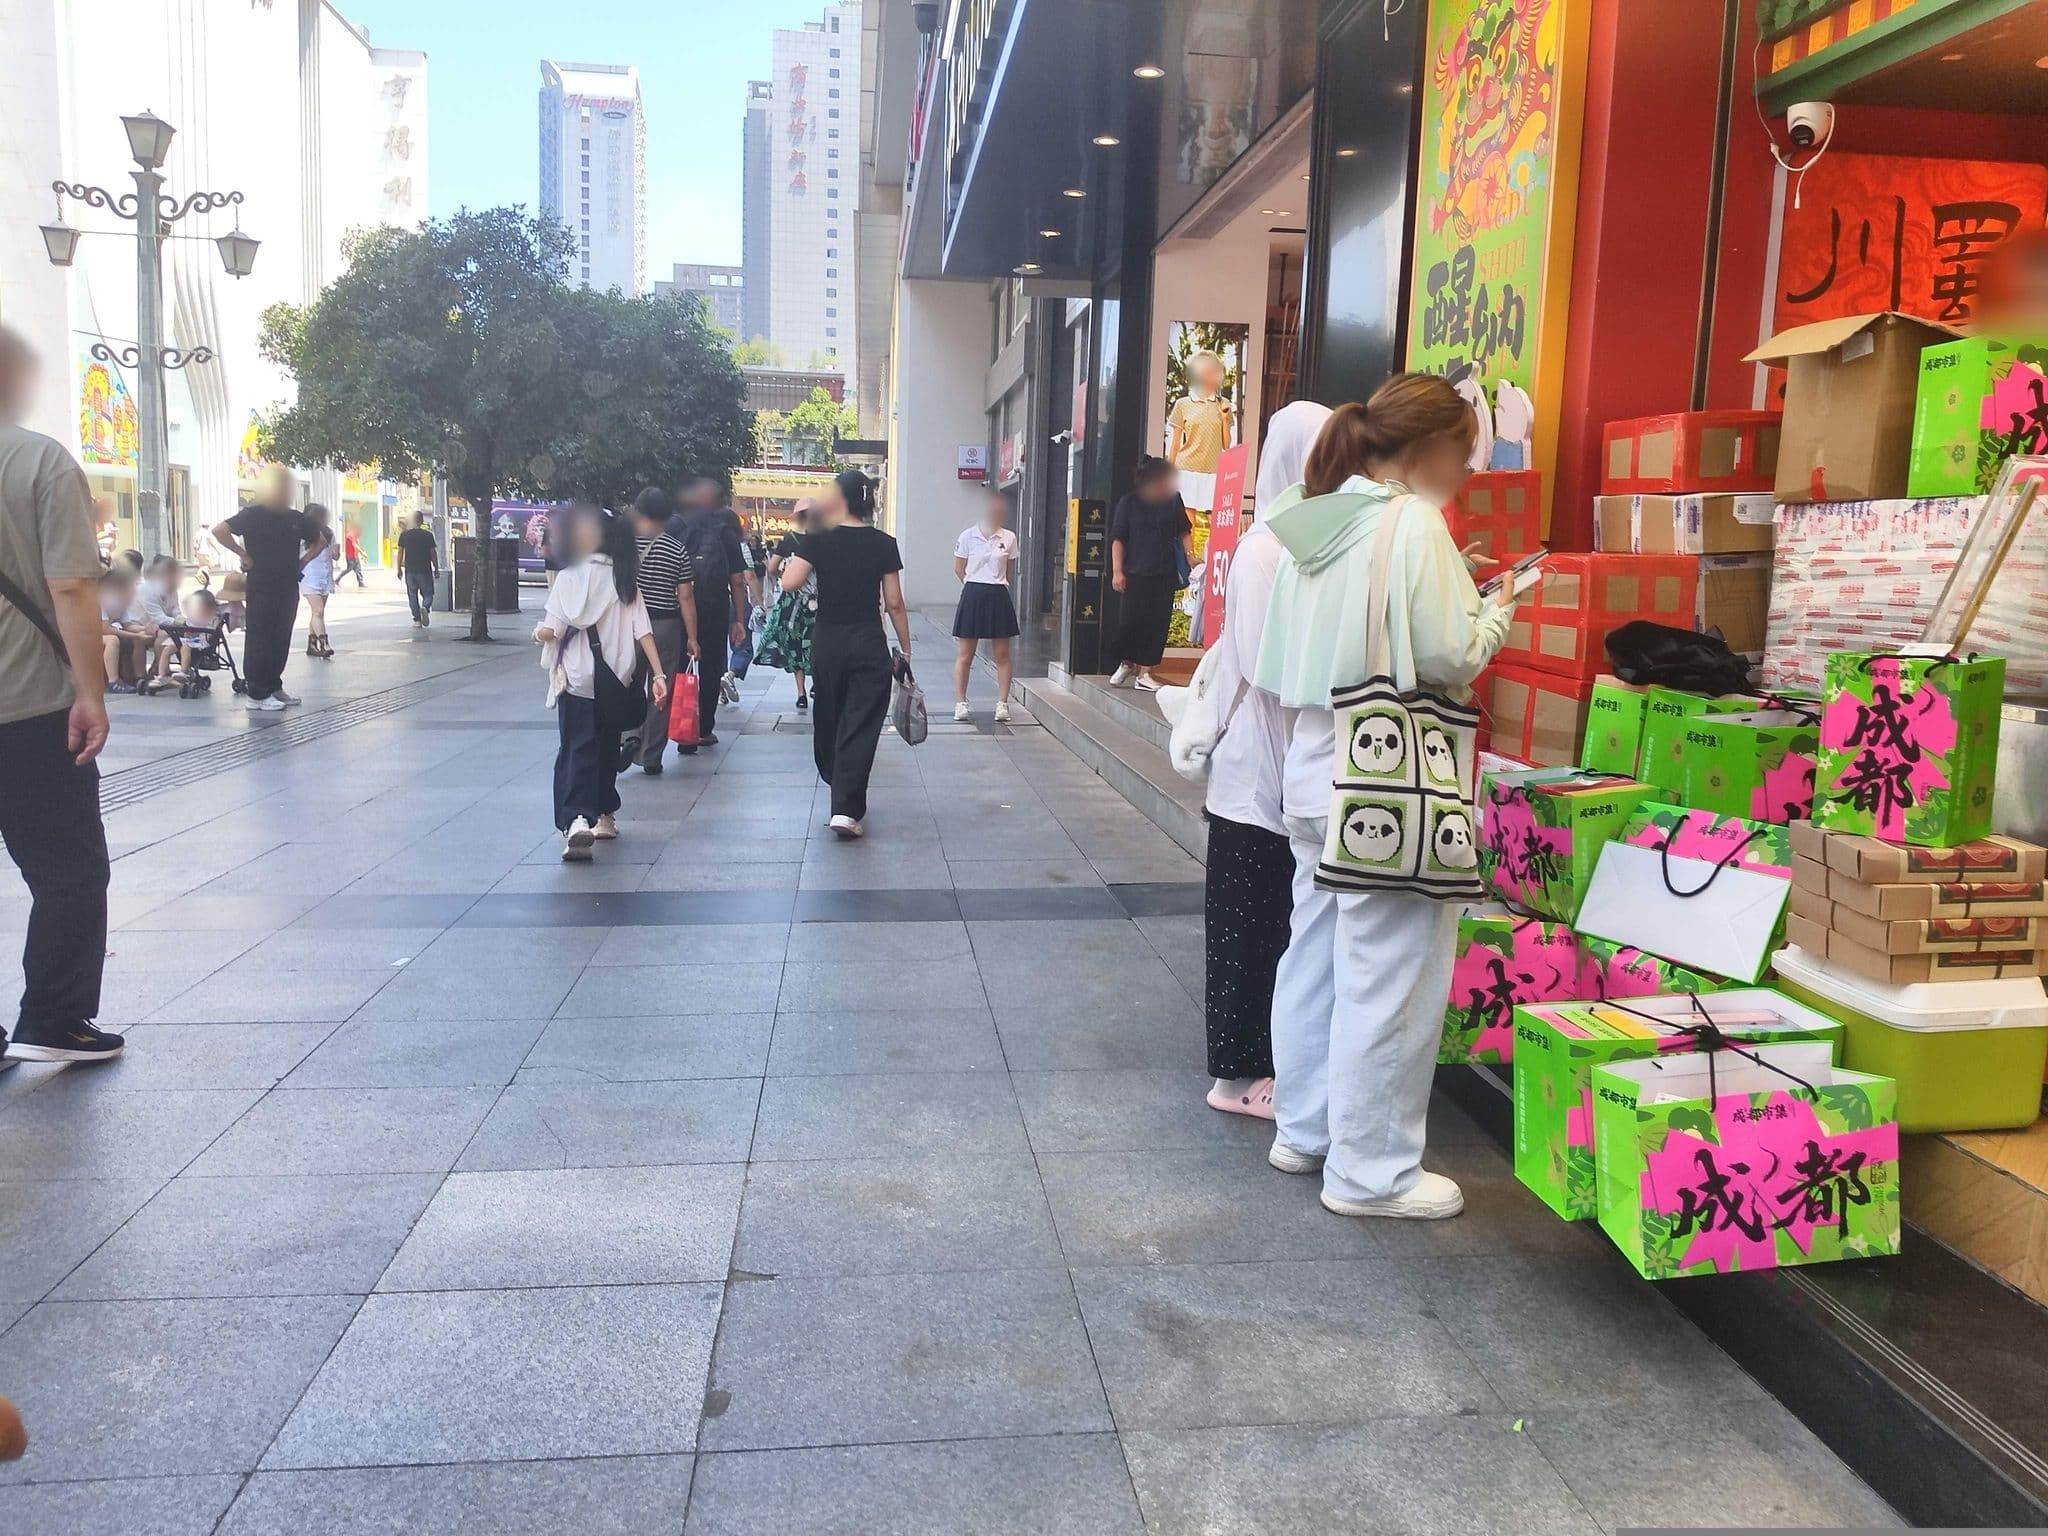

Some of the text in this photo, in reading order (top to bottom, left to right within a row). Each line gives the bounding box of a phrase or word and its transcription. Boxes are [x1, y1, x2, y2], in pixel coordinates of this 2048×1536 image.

[563, 94, 634, 112] Hampton
[1212, 550, 1229, 597] 50
[1831, 684, 1920, 829] 成都
[1490, 812, 1558, 900] 成都
[1668, 1139, 1873, 1242] 成都
